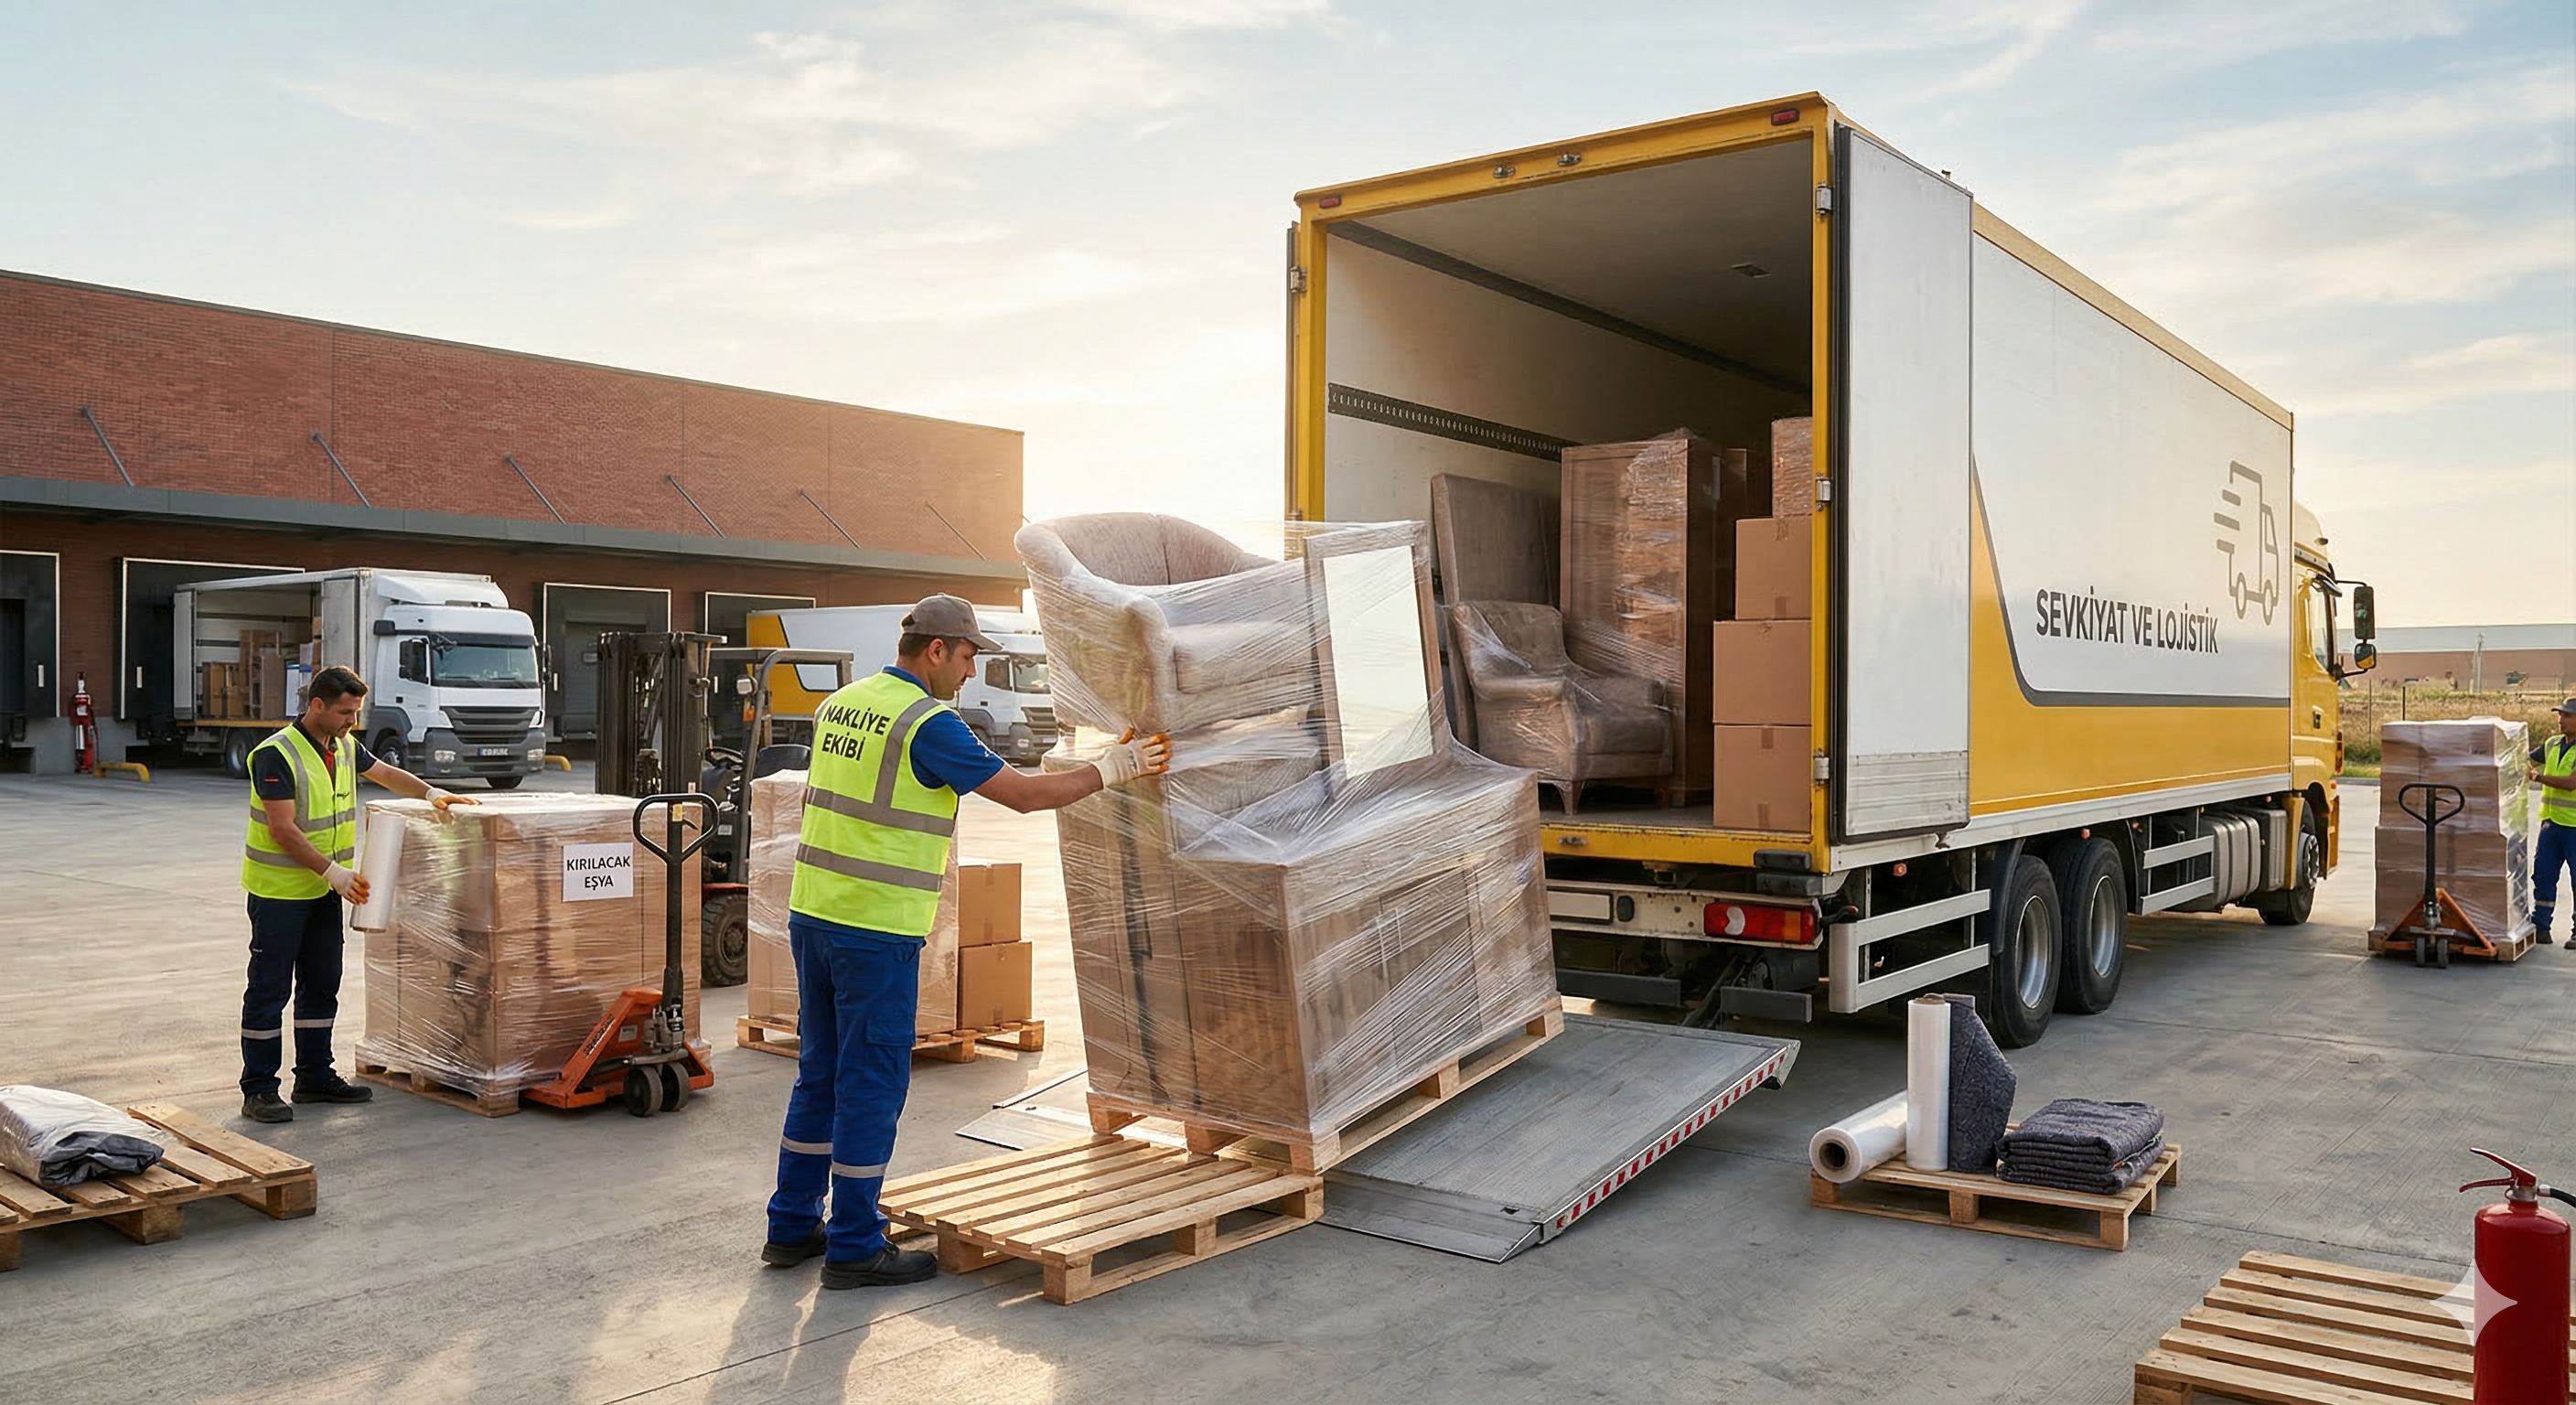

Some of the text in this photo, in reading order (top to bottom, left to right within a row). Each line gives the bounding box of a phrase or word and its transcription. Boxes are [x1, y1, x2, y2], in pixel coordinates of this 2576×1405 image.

[2036, 585, 2218, 654] SEVKİYAT VE LOJİSTİK
[822, 704, 891, 735] NAKLİYE
[821, 731, 866, 761] EKİBİ
[566, 855, 631, 871] KIRILACAK
[585, 874, 614, 891] EŞYA
